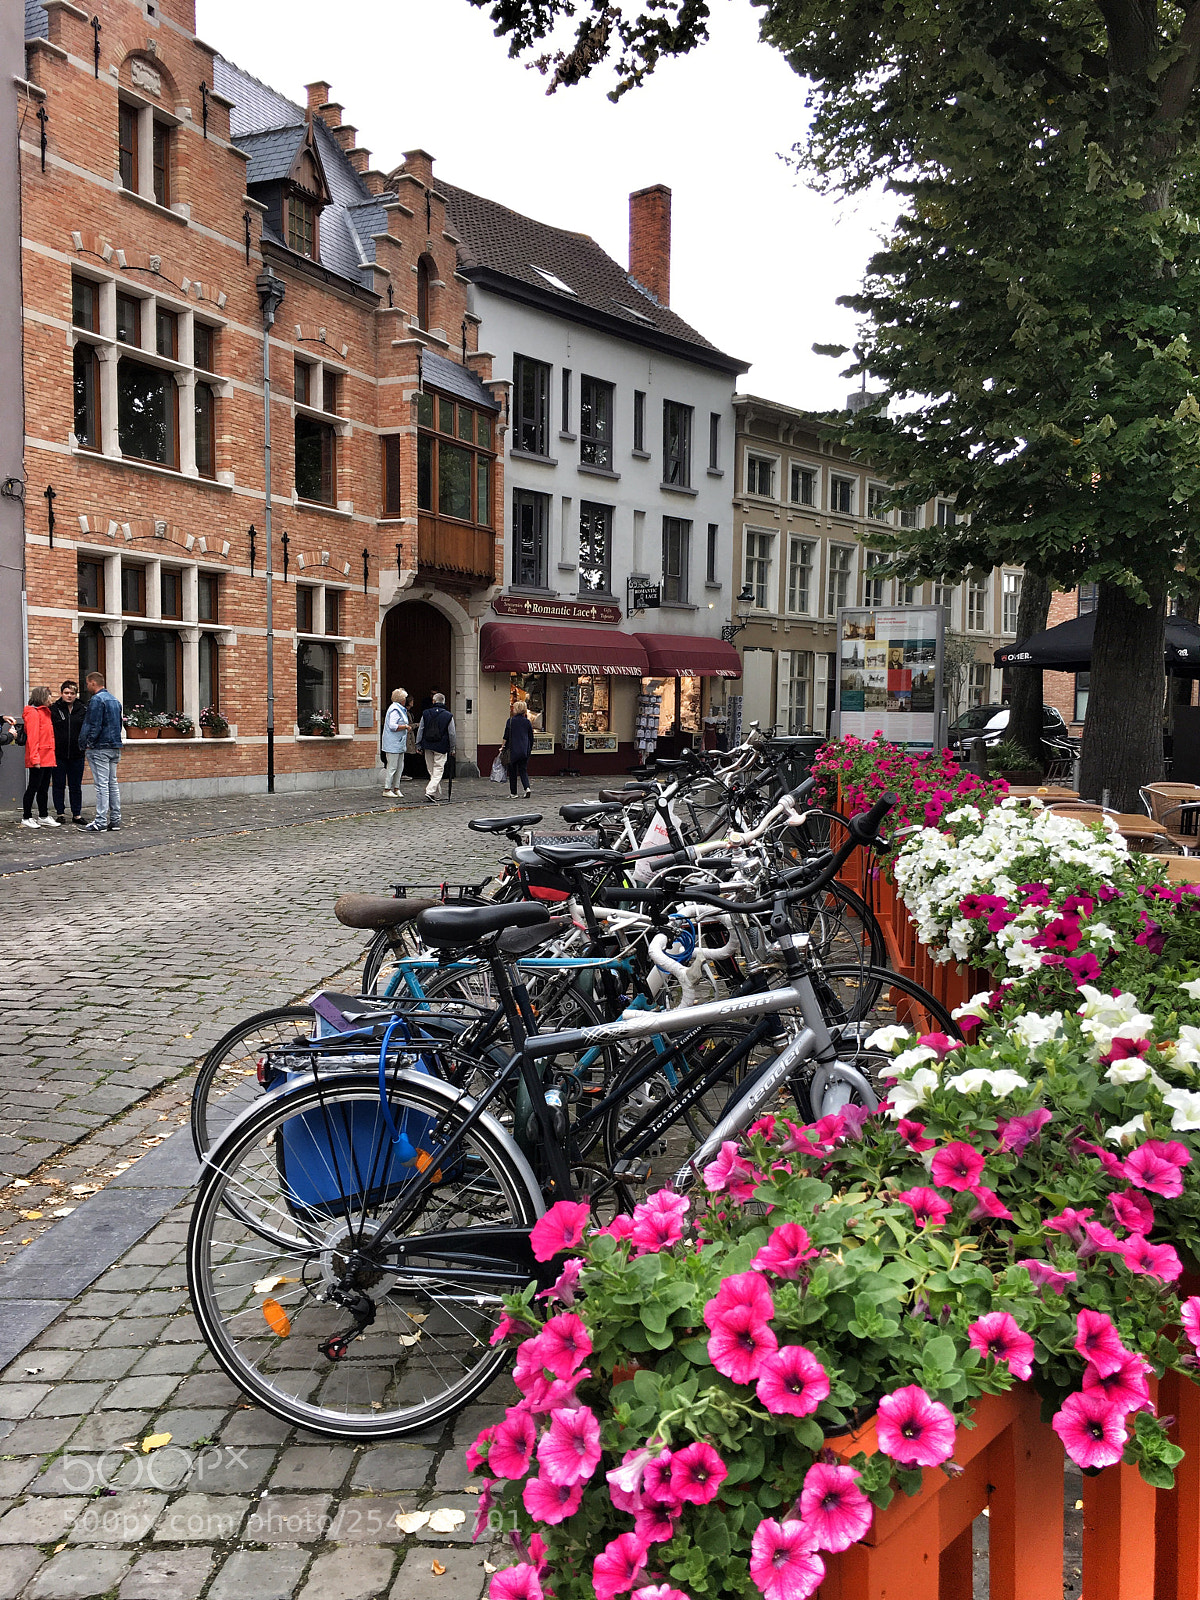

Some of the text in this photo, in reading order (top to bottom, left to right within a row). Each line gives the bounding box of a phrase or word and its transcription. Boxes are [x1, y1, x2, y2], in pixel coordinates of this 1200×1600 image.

[532, 602, 590, 618] Romantic Lace
[527, 662, 642, 677] BELGIAN TAPESTRY SOUVENIRS
[675, 669, 737, 677] LACE GIFTS
[720, 996, 774, 1015] STREET
